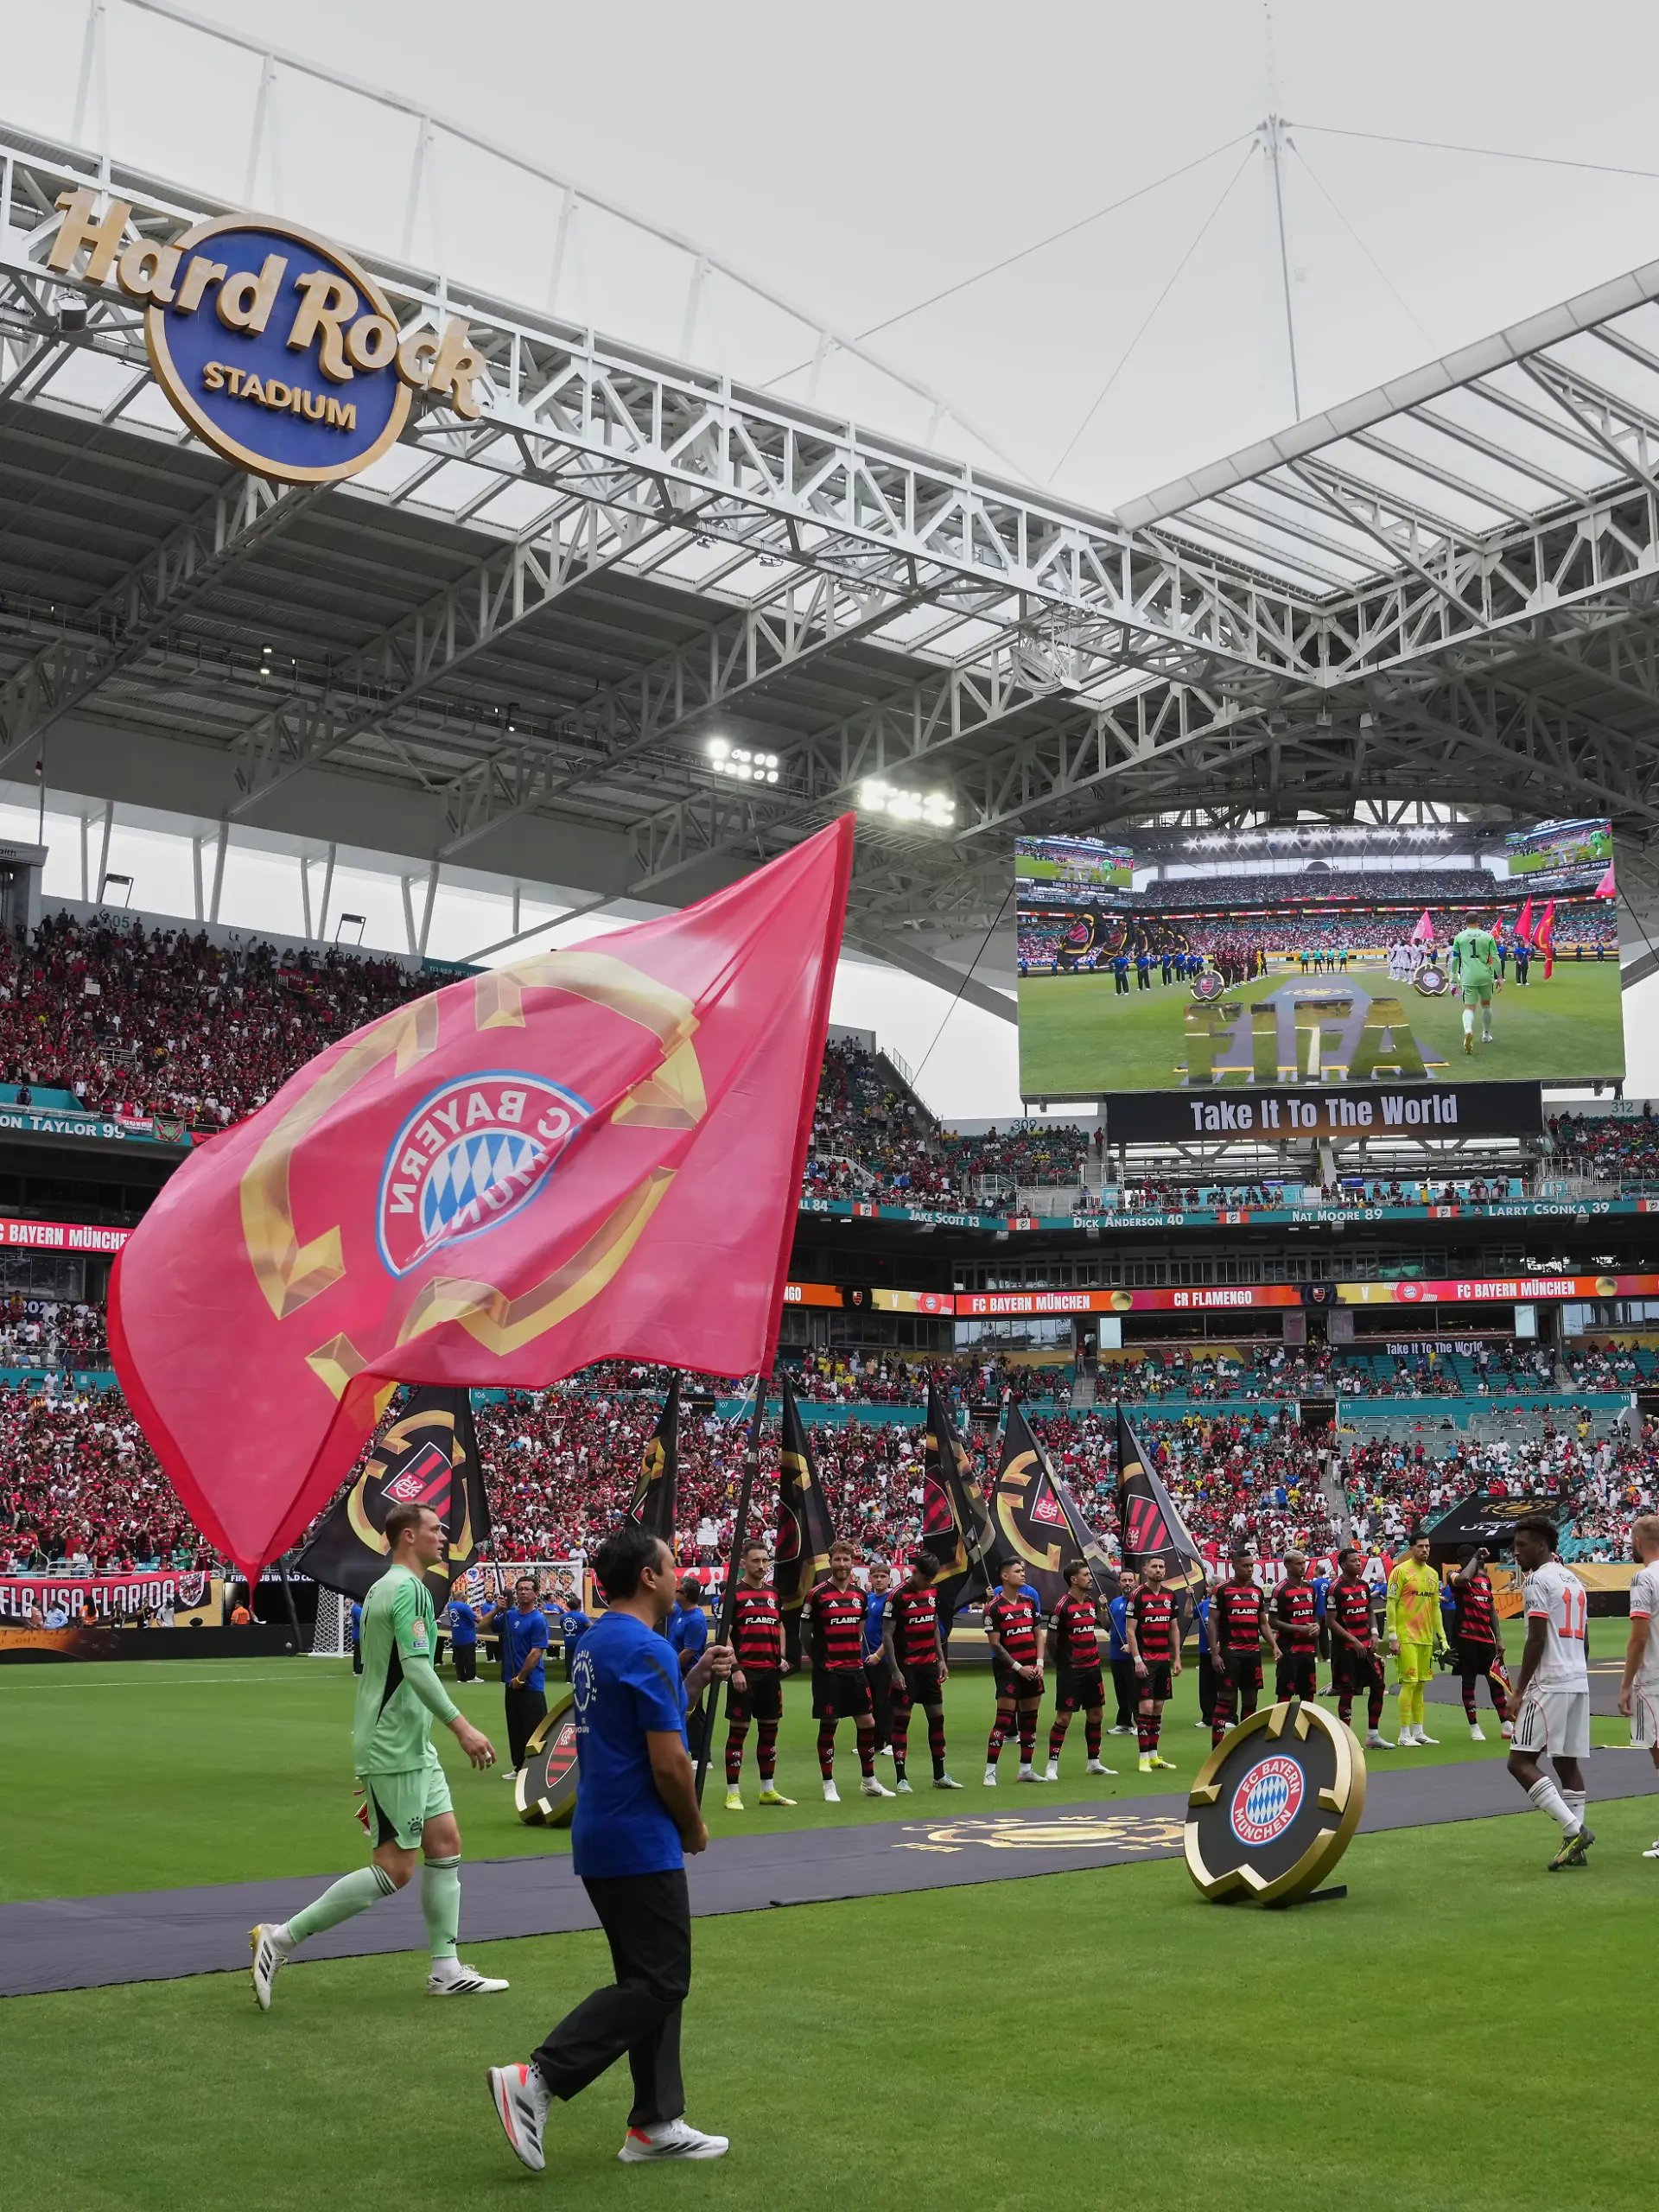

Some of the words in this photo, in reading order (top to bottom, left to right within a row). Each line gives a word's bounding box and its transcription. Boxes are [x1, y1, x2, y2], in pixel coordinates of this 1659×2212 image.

[46, 190, 288, 336] Hard
[287, 270, 486, 421] Rock
[202, 361, 357, 432] STADIUM
[1553, 866, 1575, 874] WORLD
[1470, 938, 1479, 958] 1
[1185, 997, 1431, 1084] FIFA
[1190, 1101, 1252, 1130] Take
[1262, 1099, 1280, 1128] It
[1287, 1098, 1318, 1128] To
[1325, 1097, 1373, 1127] The
[1381, 1094, 1458, 1125] World
[1611, 1101, 1633, 1114] 312
[29, 1116, 97, 1137] TAYLOR
[103, 1123, 125, 1139] 99
[1013, 1119, 1037, 1131] 309
[812, 1199, 828, 1211] 84
[1488, 1205, 1529, 1217] LARRY
[1534, 1204, 1586, 1215] CSONKA
[1592, 1202, 1610, 1213] 39
[908, 1210, 933, 1223] JAKE
[935, 1212, 965, 1226] SCOTT
[968, 1215, 980, 1227] 13
[1073, 1217, 1099, 1229] DICK
[1104, 1216, 1163, 1228] ANDERSON
[1166, 1214, 1184, 1225] 40
[1292, 1211, 1313, 1222] NAT
[1317, 1210, 1360, 1222] MOORE
[1364, 1209, 1382, 1220] 89
[10, 1224, 64, 1245] BAYERN
[69, 1226, 130, 1249] MÜNCHE
[1361, 1287, 1368, 1300] V
[1457, 1284, 1471, 1299] FC
[1474, 1281, 1516, 1298] BAYERN
[1521, 1280, 1575, 1296] MÜNCHEN
[892, 1294, 898, 1307] V
[972, 1298, 986, 1312] FC
[989, 1296, 1032, 1312] BAYERN
[1036, 1294, 1090, 1310] MÜNCHEN
[1173, 1293, 1189, 1306] CR
[1192, 1290, 1252, 1306] FLAMENGO
[1386, 1343, 1408, 1355] Take
[1411, 1343, 1419, 1354] It
[1434, 1341, 1452, 1353] The
[41, 1587, 84, 1618] USA
[92, 1579, 175, 1618] FLORIDA
[745, 1617, 777, 1625] FLABET
[909, 1614, 934, 1624] FLABE
[1559, 1587, 1585, 1640] 11
[1242, 1772, 1259, 1793] FC
[1262, 1760, 1300, 1795] BAYERN
